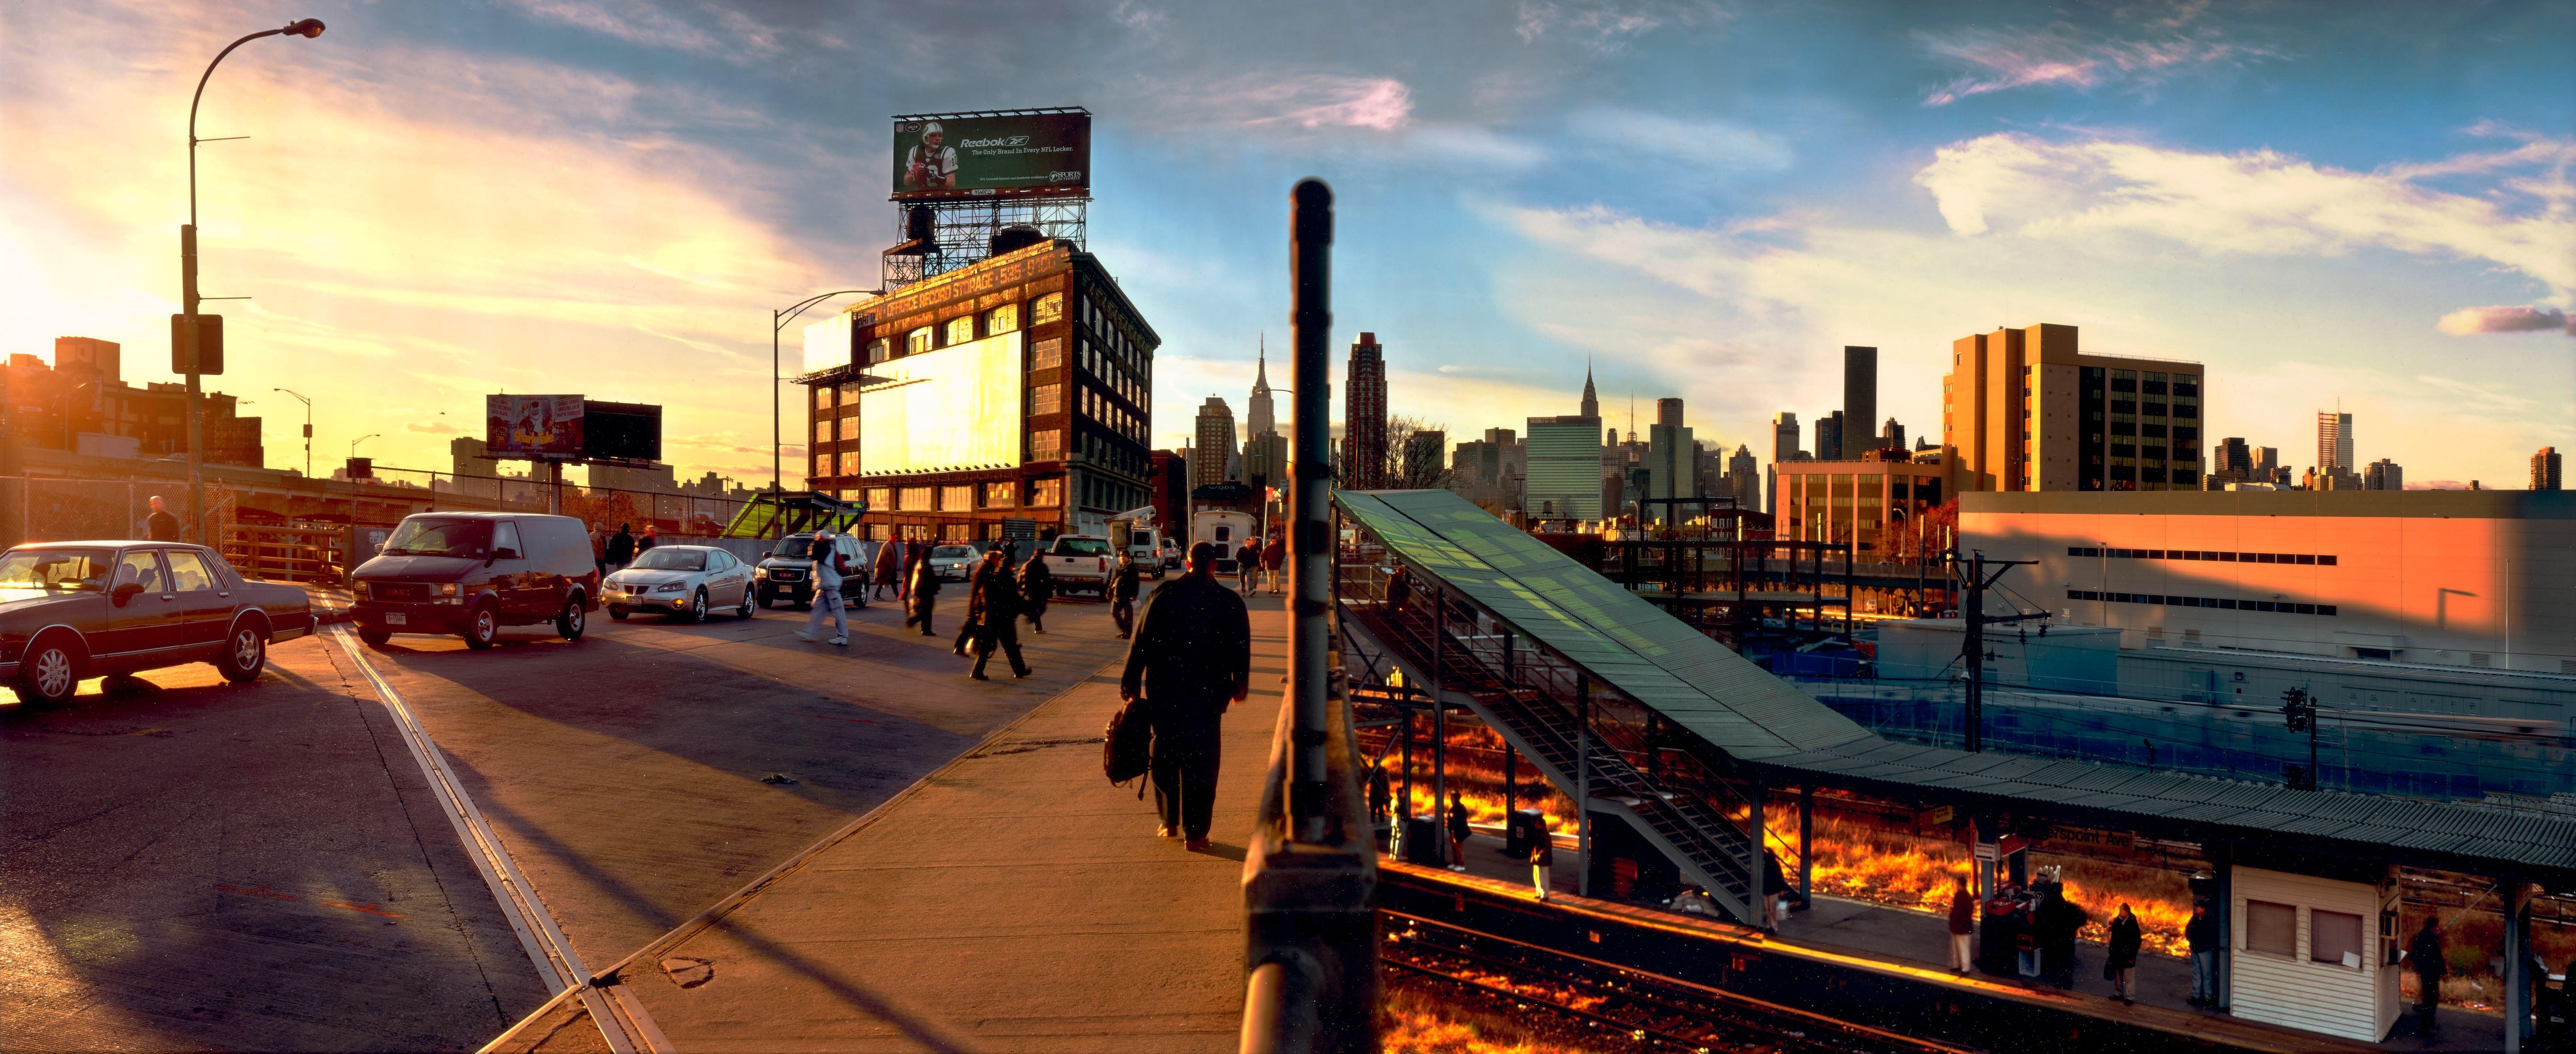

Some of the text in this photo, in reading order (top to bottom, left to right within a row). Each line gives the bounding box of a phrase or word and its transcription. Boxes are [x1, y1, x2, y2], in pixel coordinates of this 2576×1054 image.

[961, 137, 1005, 148] Reebok
[919, 284, 951, 308] RECORD
[953, 271, 993, 298] STORAGE
[514, 430, 554, 444] Shark Tale
[2105, 831, 2130, 847] Ave
